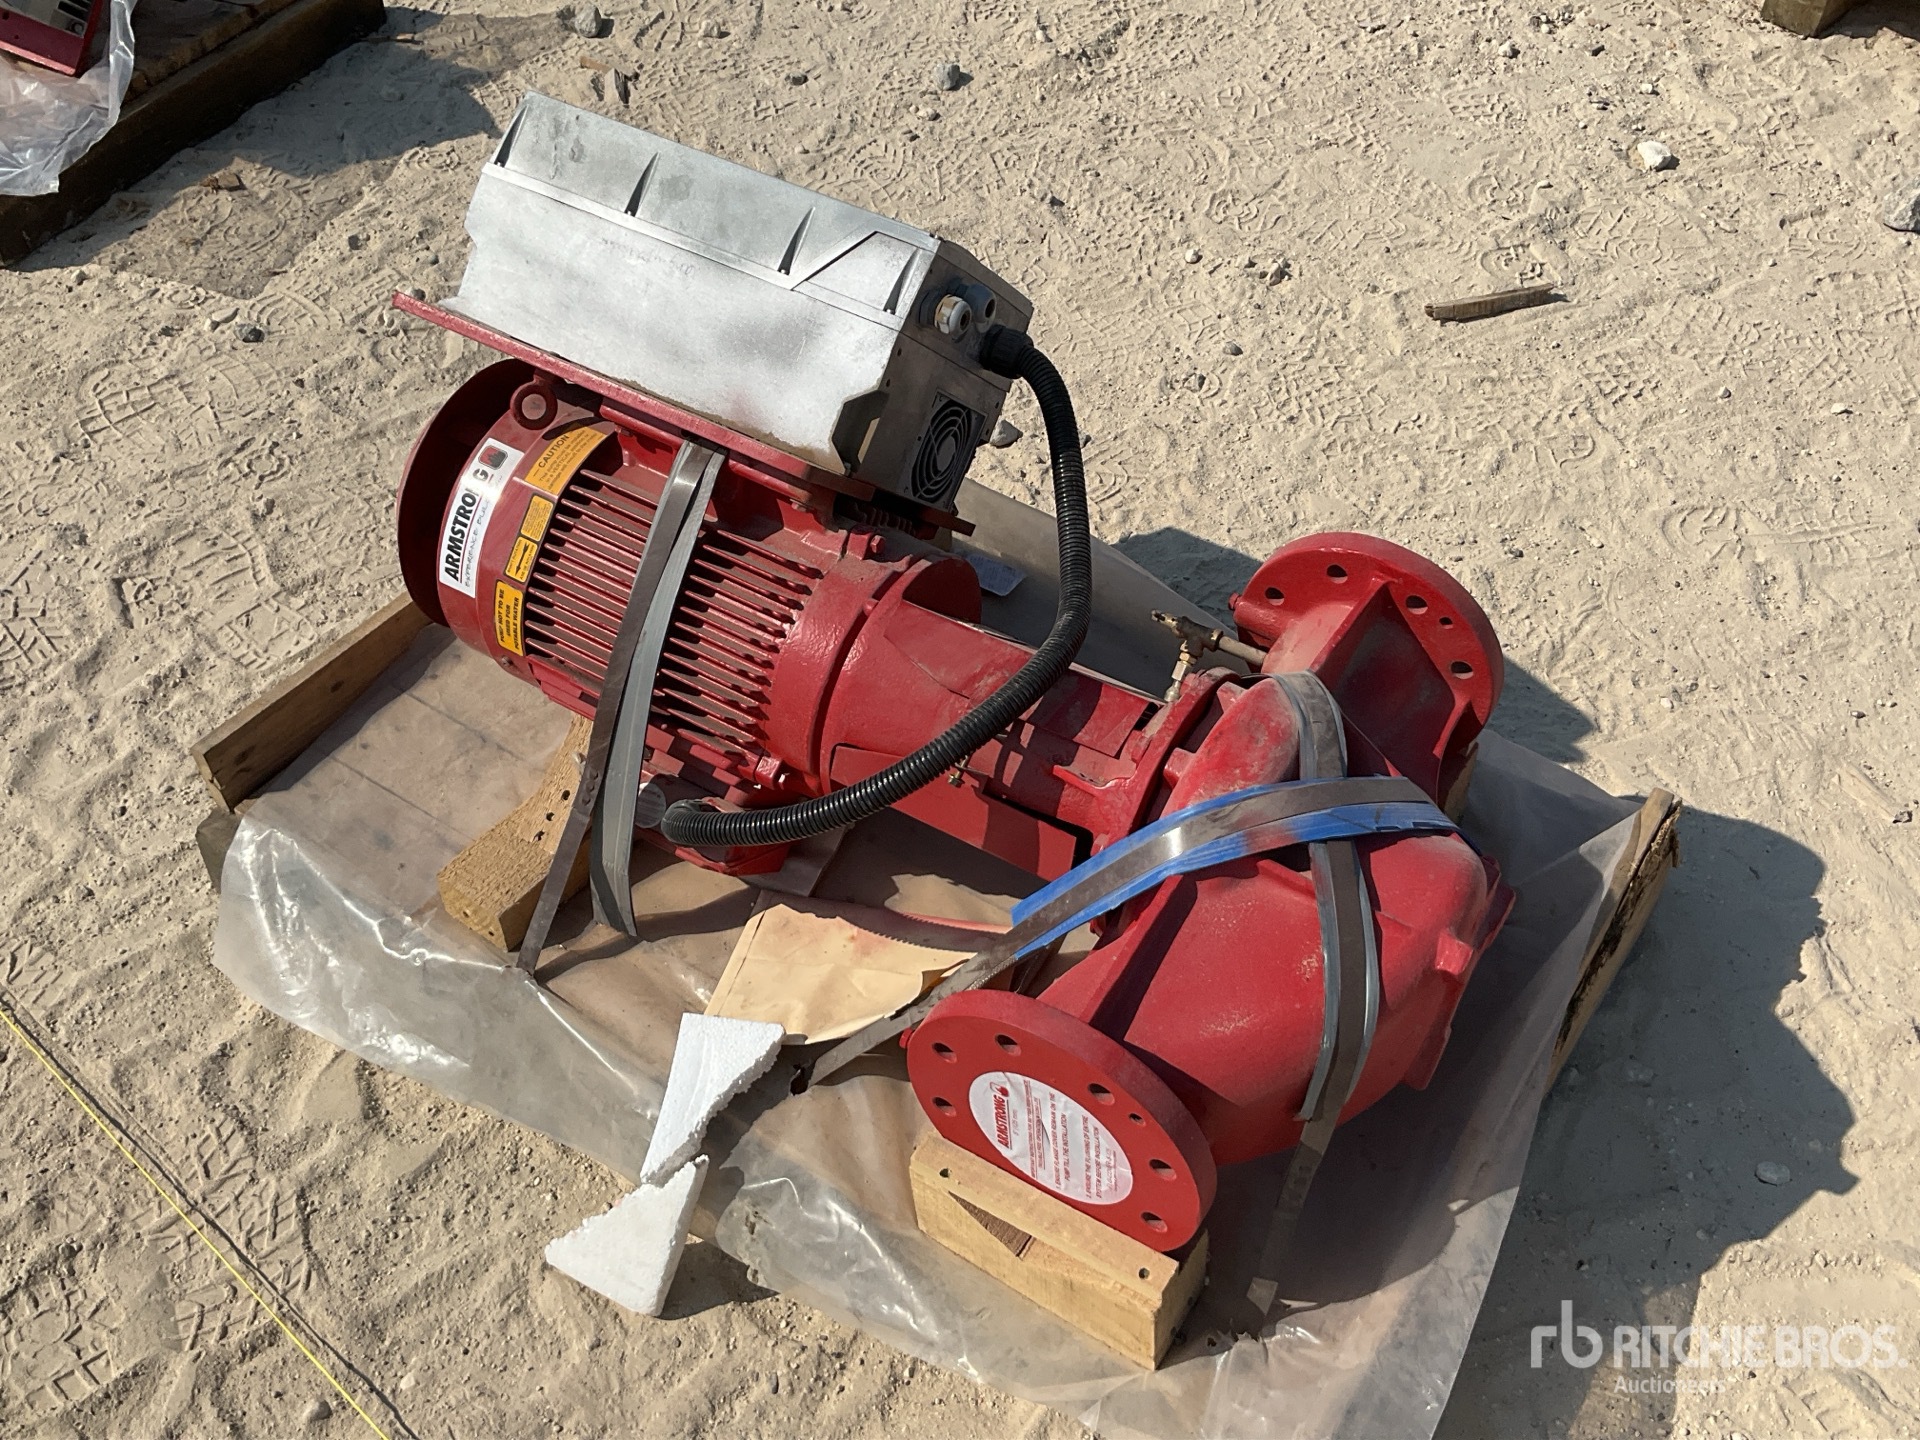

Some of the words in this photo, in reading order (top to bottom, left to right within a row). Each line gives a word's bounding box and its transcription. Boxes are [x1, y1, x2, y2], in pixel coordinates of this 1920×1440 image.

[538, 435, 569, 467] CAUTION
[553, 452, 570, 473] VERTICAL
[445, 468, 488, 581] ARMSTROG
[498, 600, 504, 609] TO
[499, 589, 504, 598] BE
[1050, 1101, 1056, 1110] ON
[994, 1096, 1009, 1148] ARMSTRONG
[1061, 1114, 1069, 1147] INSTALLATION
[1083, 1131, 1089, 1139] OF
[1093, 1127, 1101, 1159] INSTALLATION
[1083, 1139, 1091, 1163] FLUSHING
